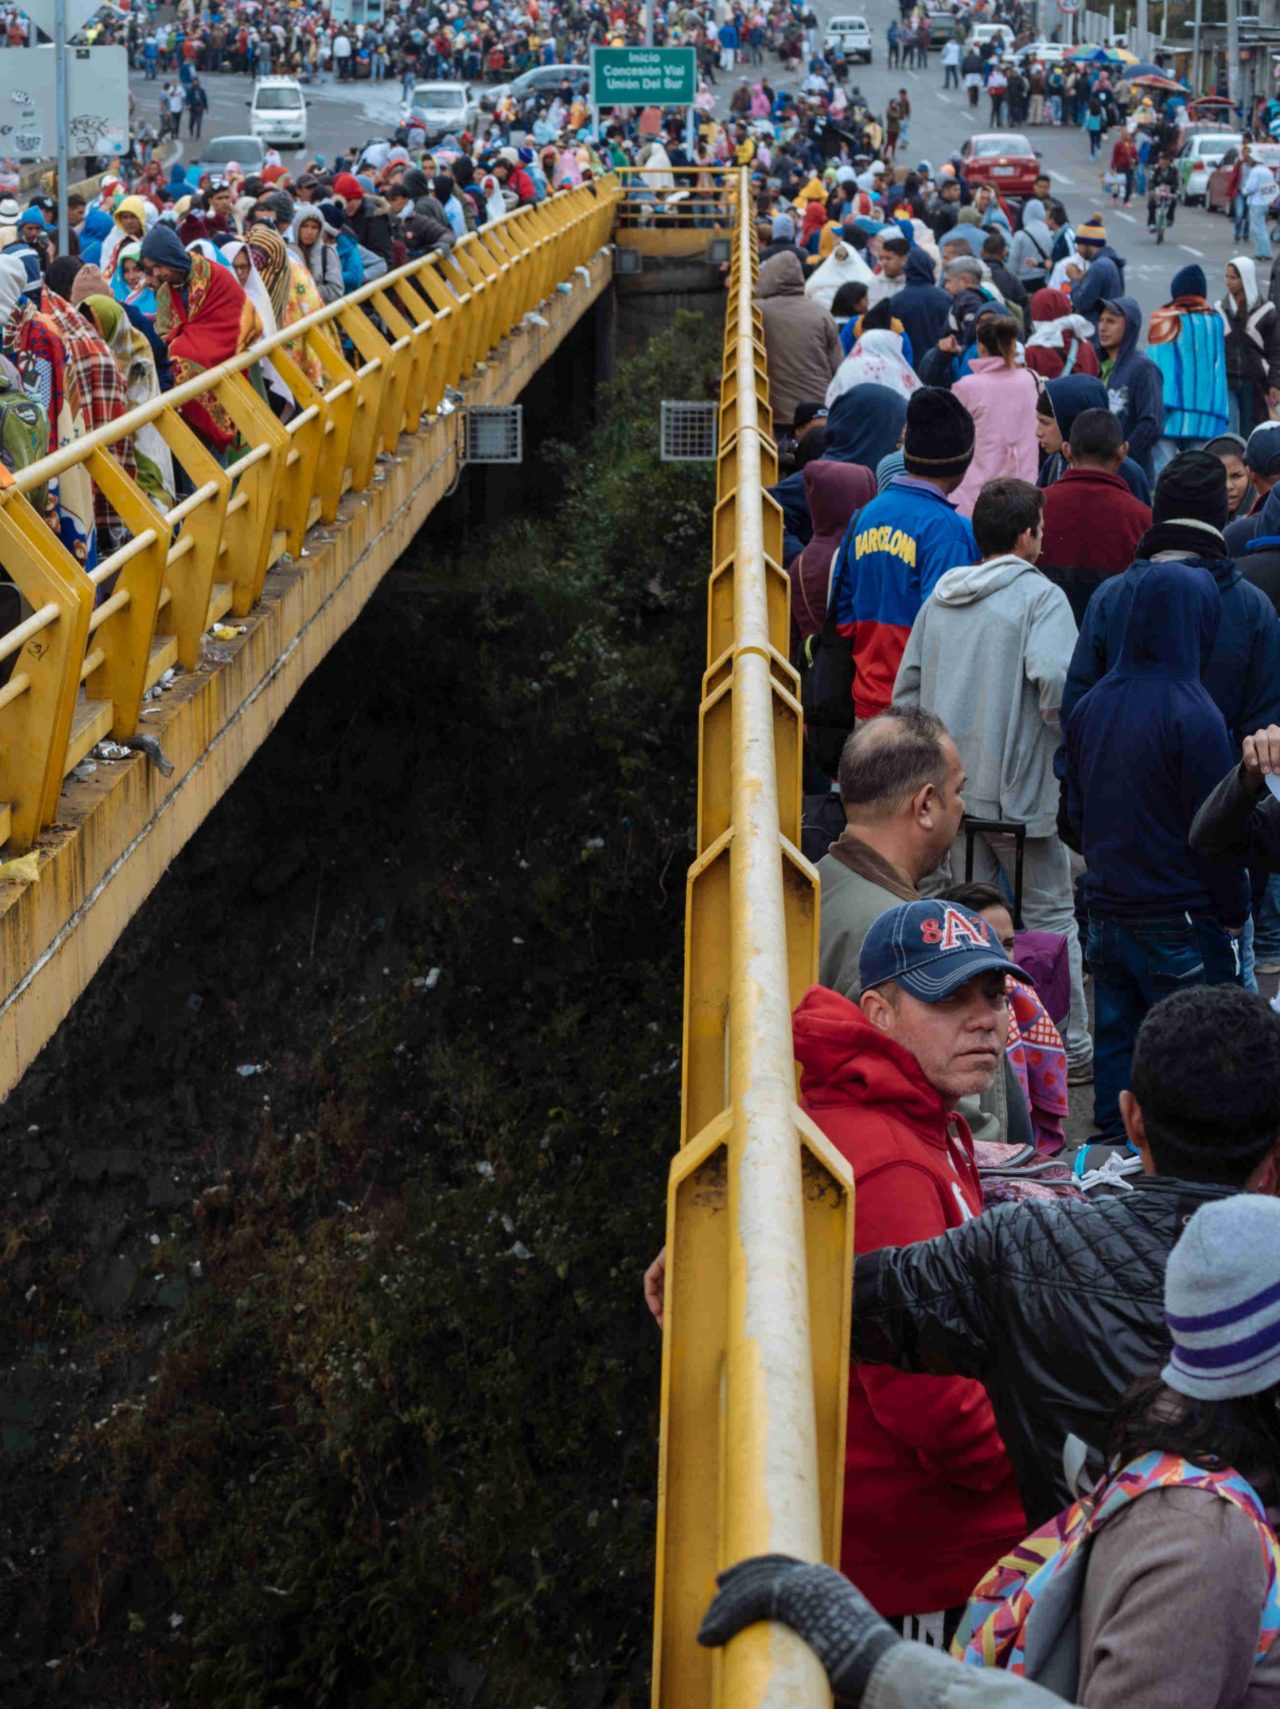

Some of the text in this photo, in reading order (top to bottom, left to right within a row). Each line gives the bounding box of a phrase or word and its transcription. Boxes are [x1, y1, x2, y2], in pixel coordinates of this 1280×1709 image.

[628, 51, 661, 63] Inicio
[602, 64, 686, 76] Concesión Vial
[606, 76, 684, 90] Unión Del Sur
